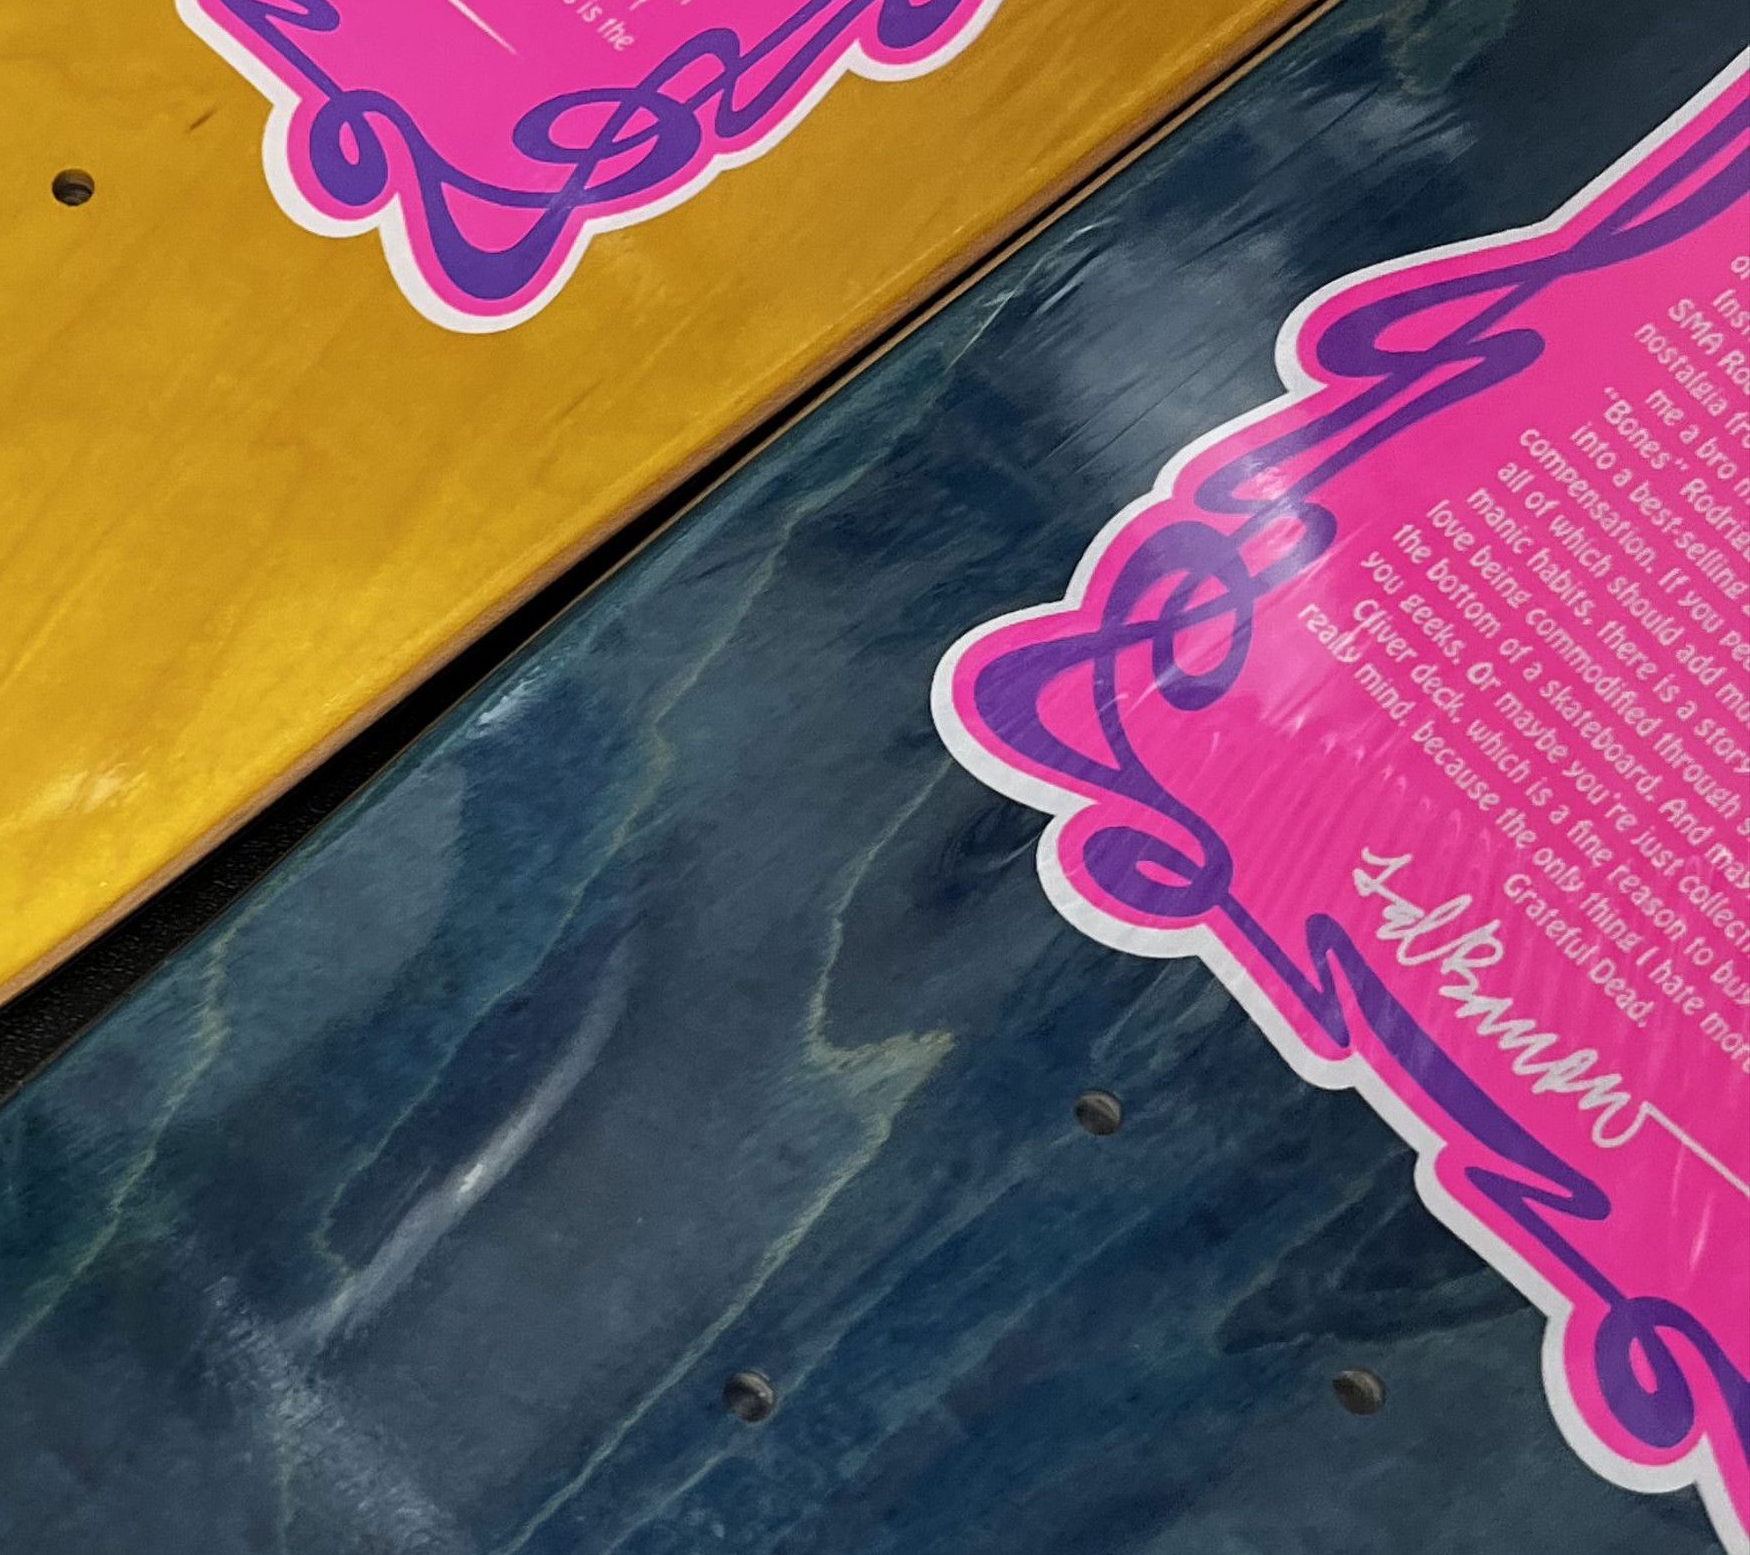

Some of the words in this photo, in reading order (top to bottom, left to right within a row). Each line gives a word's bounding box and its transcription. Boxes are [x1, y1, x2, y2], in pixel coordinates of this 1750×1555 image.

[1633, 321, 1728, 417] nostalgia
[1643, 387, 1685, 426] me
[1677, 423, 1700, 445] a
[1693, 435, 1738, 480] bro
[1666, 297, 1724, 355] SMA
[1465, 486, 1534, 554] manic
[1595, 619, 1658, 680] there
[1651, 673, 1681, 703] is
[1674, 698, 1698, 722] a
[1496, 461, 1535, 494] all
[1523, 490, 1560, 518] of
[1548, 513, 1612, 578] which
[1605, 575, 1685, 647] should
[1674, 642, 1727, 686] add
[1568, 421, 1617, 470] into
[1611, 467, 1634, 488] a
[1627, 479, 1750, 601] best-selling
[1657, 566, 1690, 594] If
[1676, 589, 1725, 634] you
[1359, 550, 1405, 595] you
[1465, 660, 1502, 692] Or
[1493, 690, 1569, 764] maybe
[1629, 825, 1685, 877] just
[1391, 522, 1432, 565] the
[1424, 556, 1502, 639] bottom
[1497, 637, 1534, 664] of
[1521, 660, 1543, 682] a
[1657, 797, 1715, 846] And
[1424, 497, 1475, 552] love
[1467, 544, 1532, 609] being
[1524, 607, 1663, 737] commodified
[1652, 731, 1742, 820] through
[1296, 602, 1362, 663] really
[1409, 718, 1500, 812] because
[1494, 806, 1537, 851] the
[1531, 846, 1585, 893] only
[1578, 891, 1643, 953] thing
[1634, 945, 1659, 967] I
[1647, 957, 1706, 1016] hate
[1352, 597, 1418, 663] Cliver
[1464, 718, 1531, 784] which
[1523, 775, 1554, 807] is
[1547, 803, 1571, 825] a
[1565, 818, 1613, 868] fine
[1605, 863, 1688, 942] reason
[1682, 935, 1715, 966] to
[1502, 872, 1599, 966] Grateful
